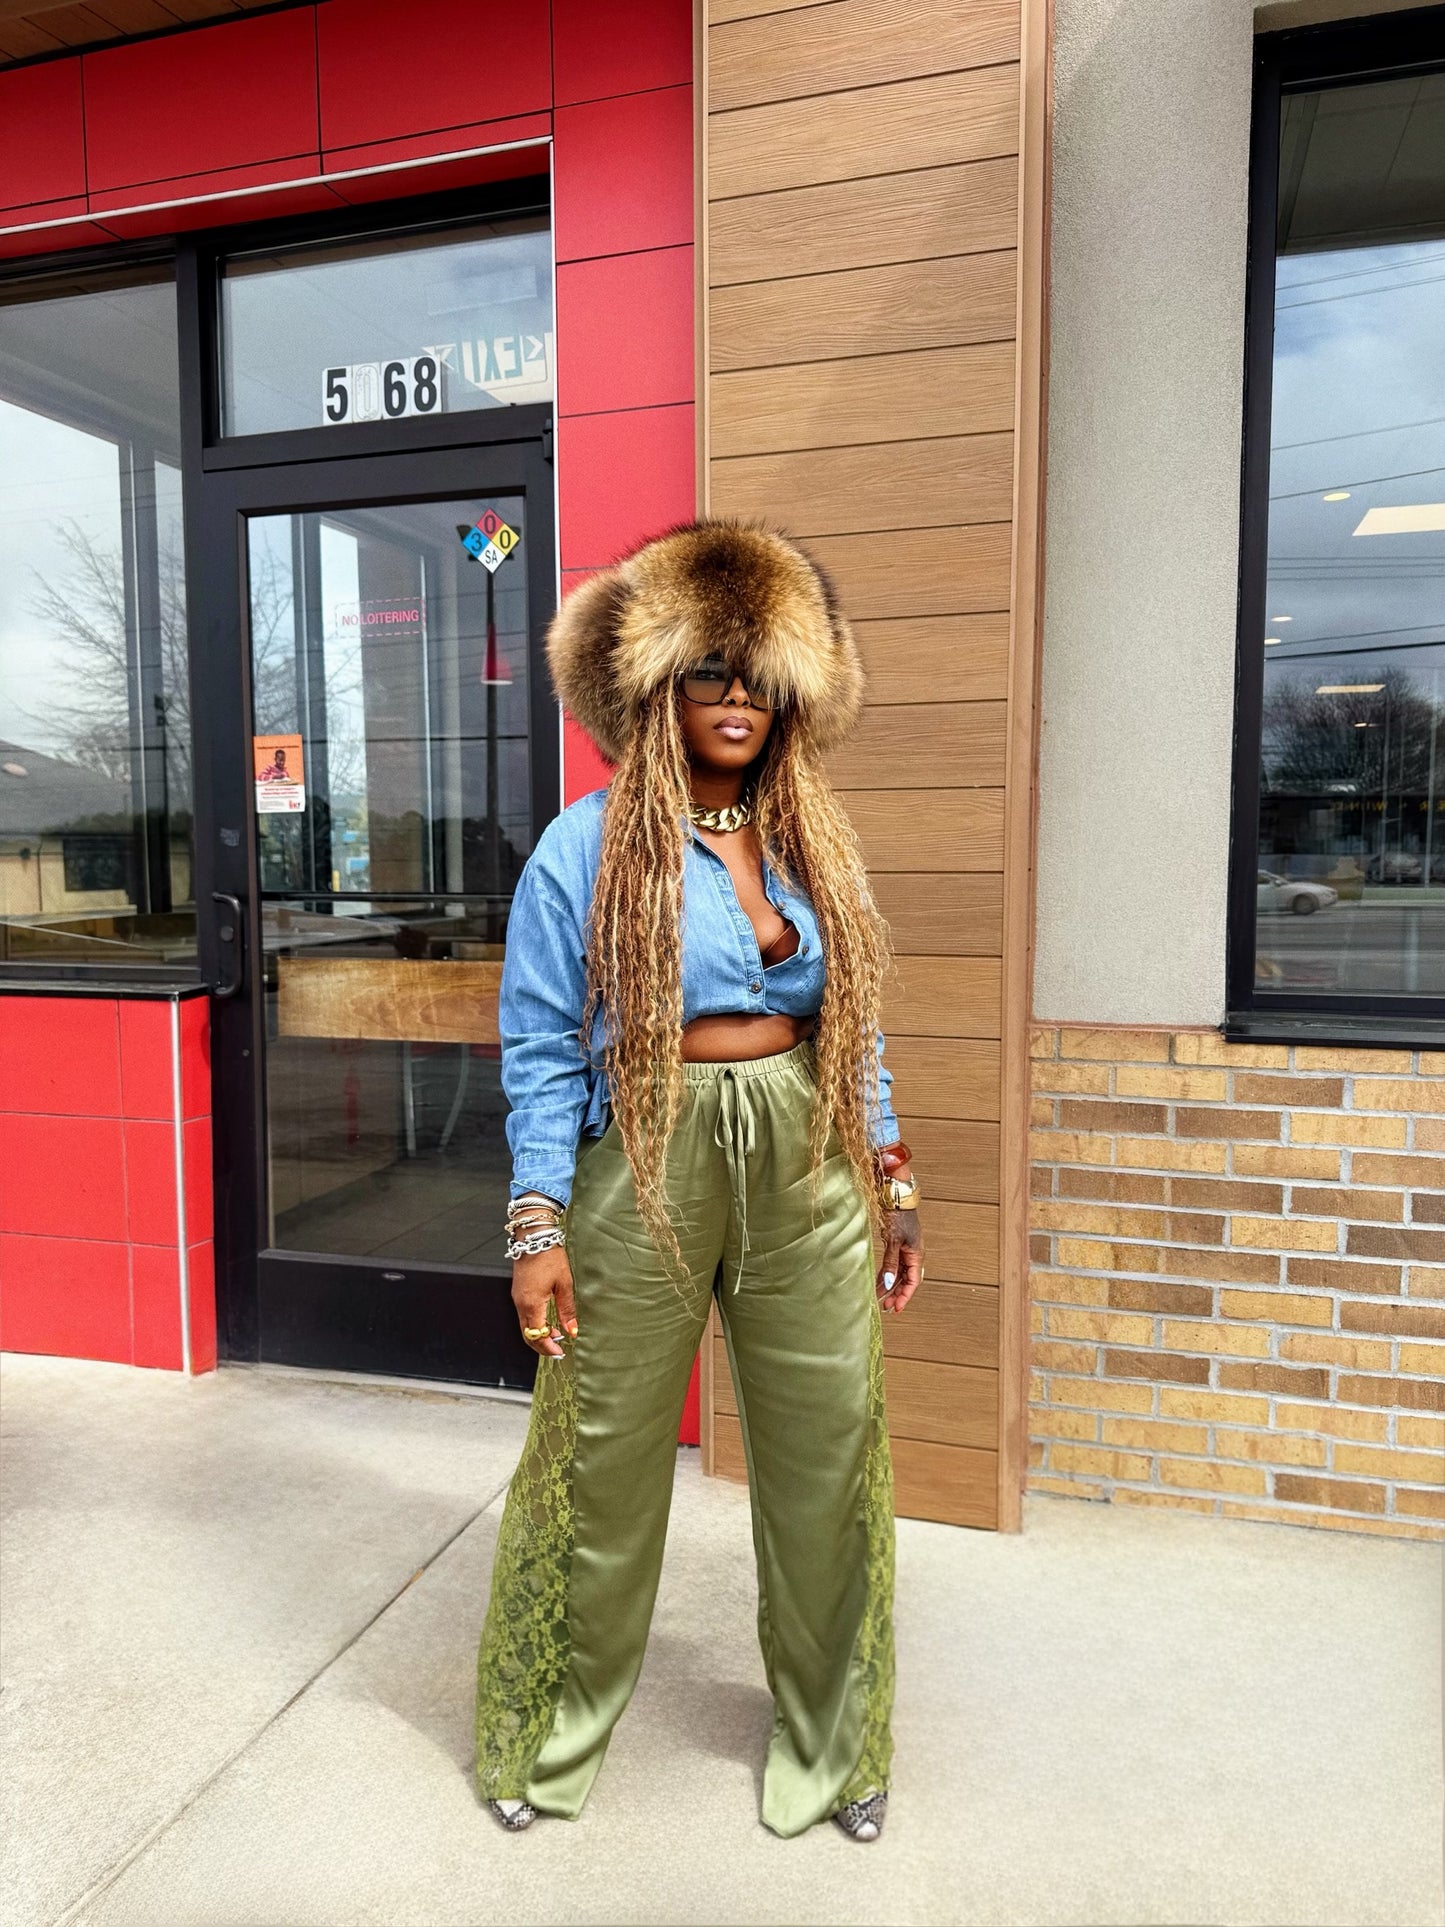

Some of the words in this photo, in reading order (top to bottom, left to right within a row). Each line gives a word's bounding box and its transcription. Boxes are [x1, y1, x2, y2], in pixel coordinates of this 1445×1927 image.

[327, 357, 437, 422] 5068
[484, 515, 497, 535] 0
[471, 532, 483, 552] 3
[499, 529, 511, 549] 0
[485, 549, 498, 564] SA
[342, 614, 359, 626] NO
[360, 609, 419, 625] LOITERING
